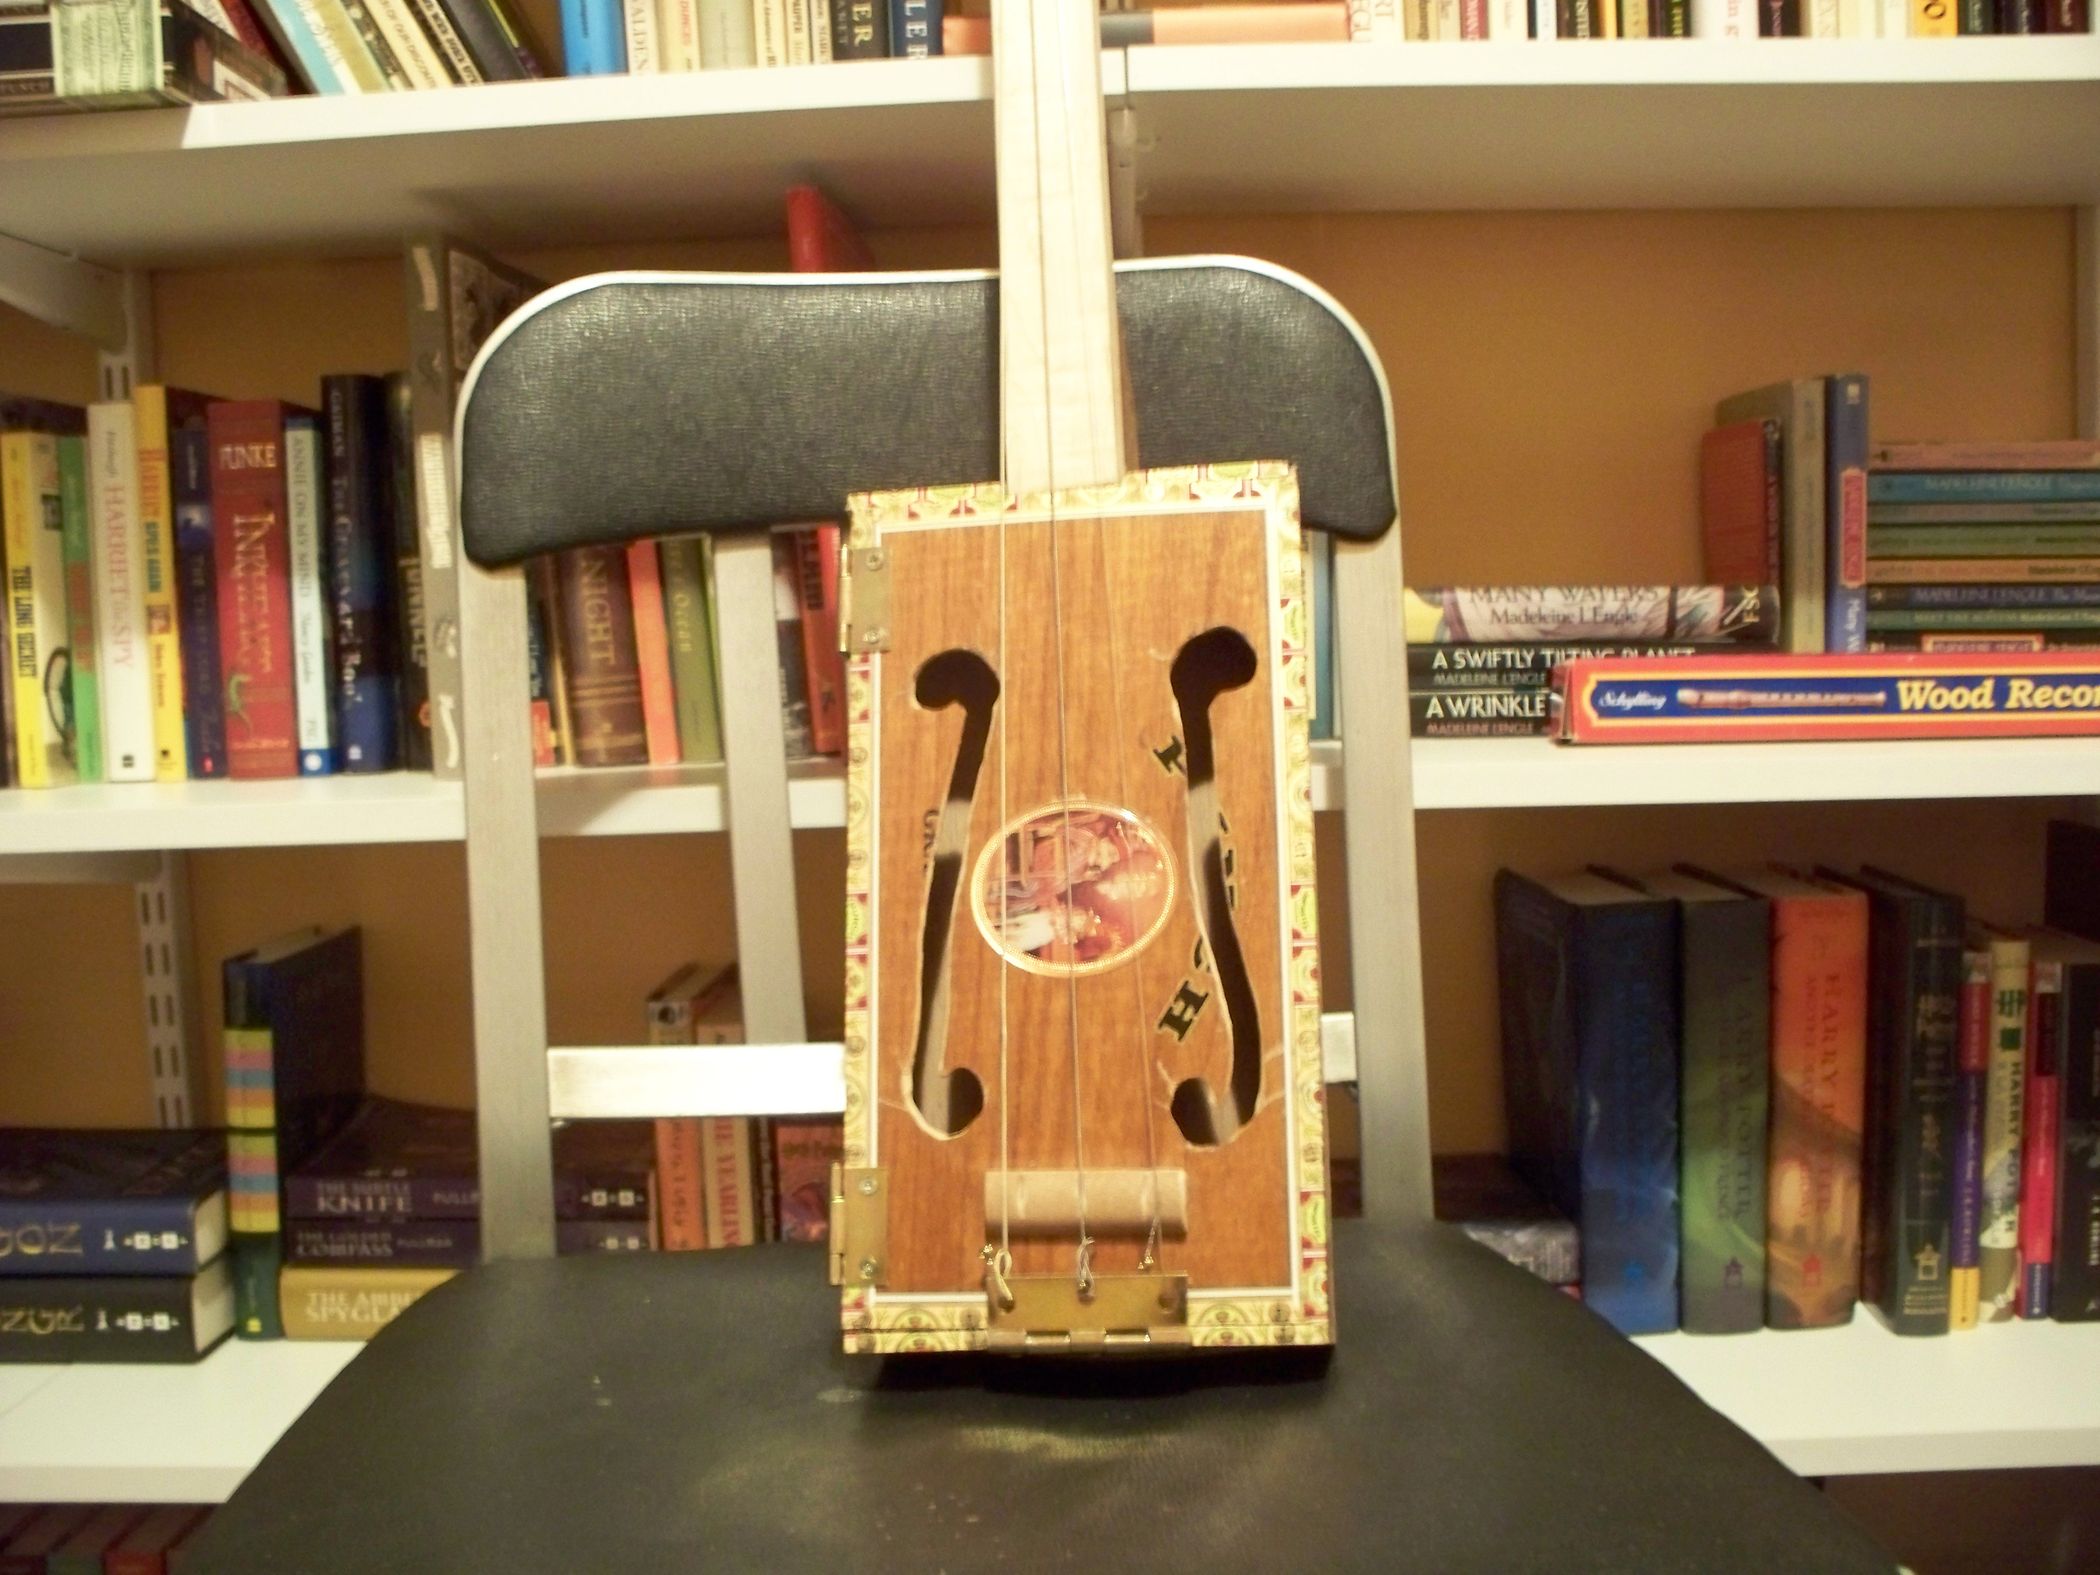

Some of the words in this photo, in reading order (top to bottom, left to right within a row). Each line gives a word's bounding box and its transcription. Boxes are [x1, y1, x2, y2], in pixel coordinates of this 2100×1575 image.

[331, 389, 345, 458] GAIMAN
[218, 441, 278, 470] FUNKE
[292, 433, 307, 485] ANNIE
[104, 484, 130, 595] HARRIET
[580, 558, 617, 667] NIGHT
[1491, 606, 1574, 625] Madeleine
[112, 625, 134, 669] SPY
[1431, 649, 1449, 670] A
[1452, 648, 1536, 670] SWIFTLY
[1425, 695, 1445, 719] A
[1445, 694, 1547, 718] WRINKLE
[1896, 677, 1996, 711] Wood
[1821, 972, 1841, 1087] HARRY
[2009, 1061, 2023, 1136] HARRY
[316, 1195, 413, 1214] KNIFE
